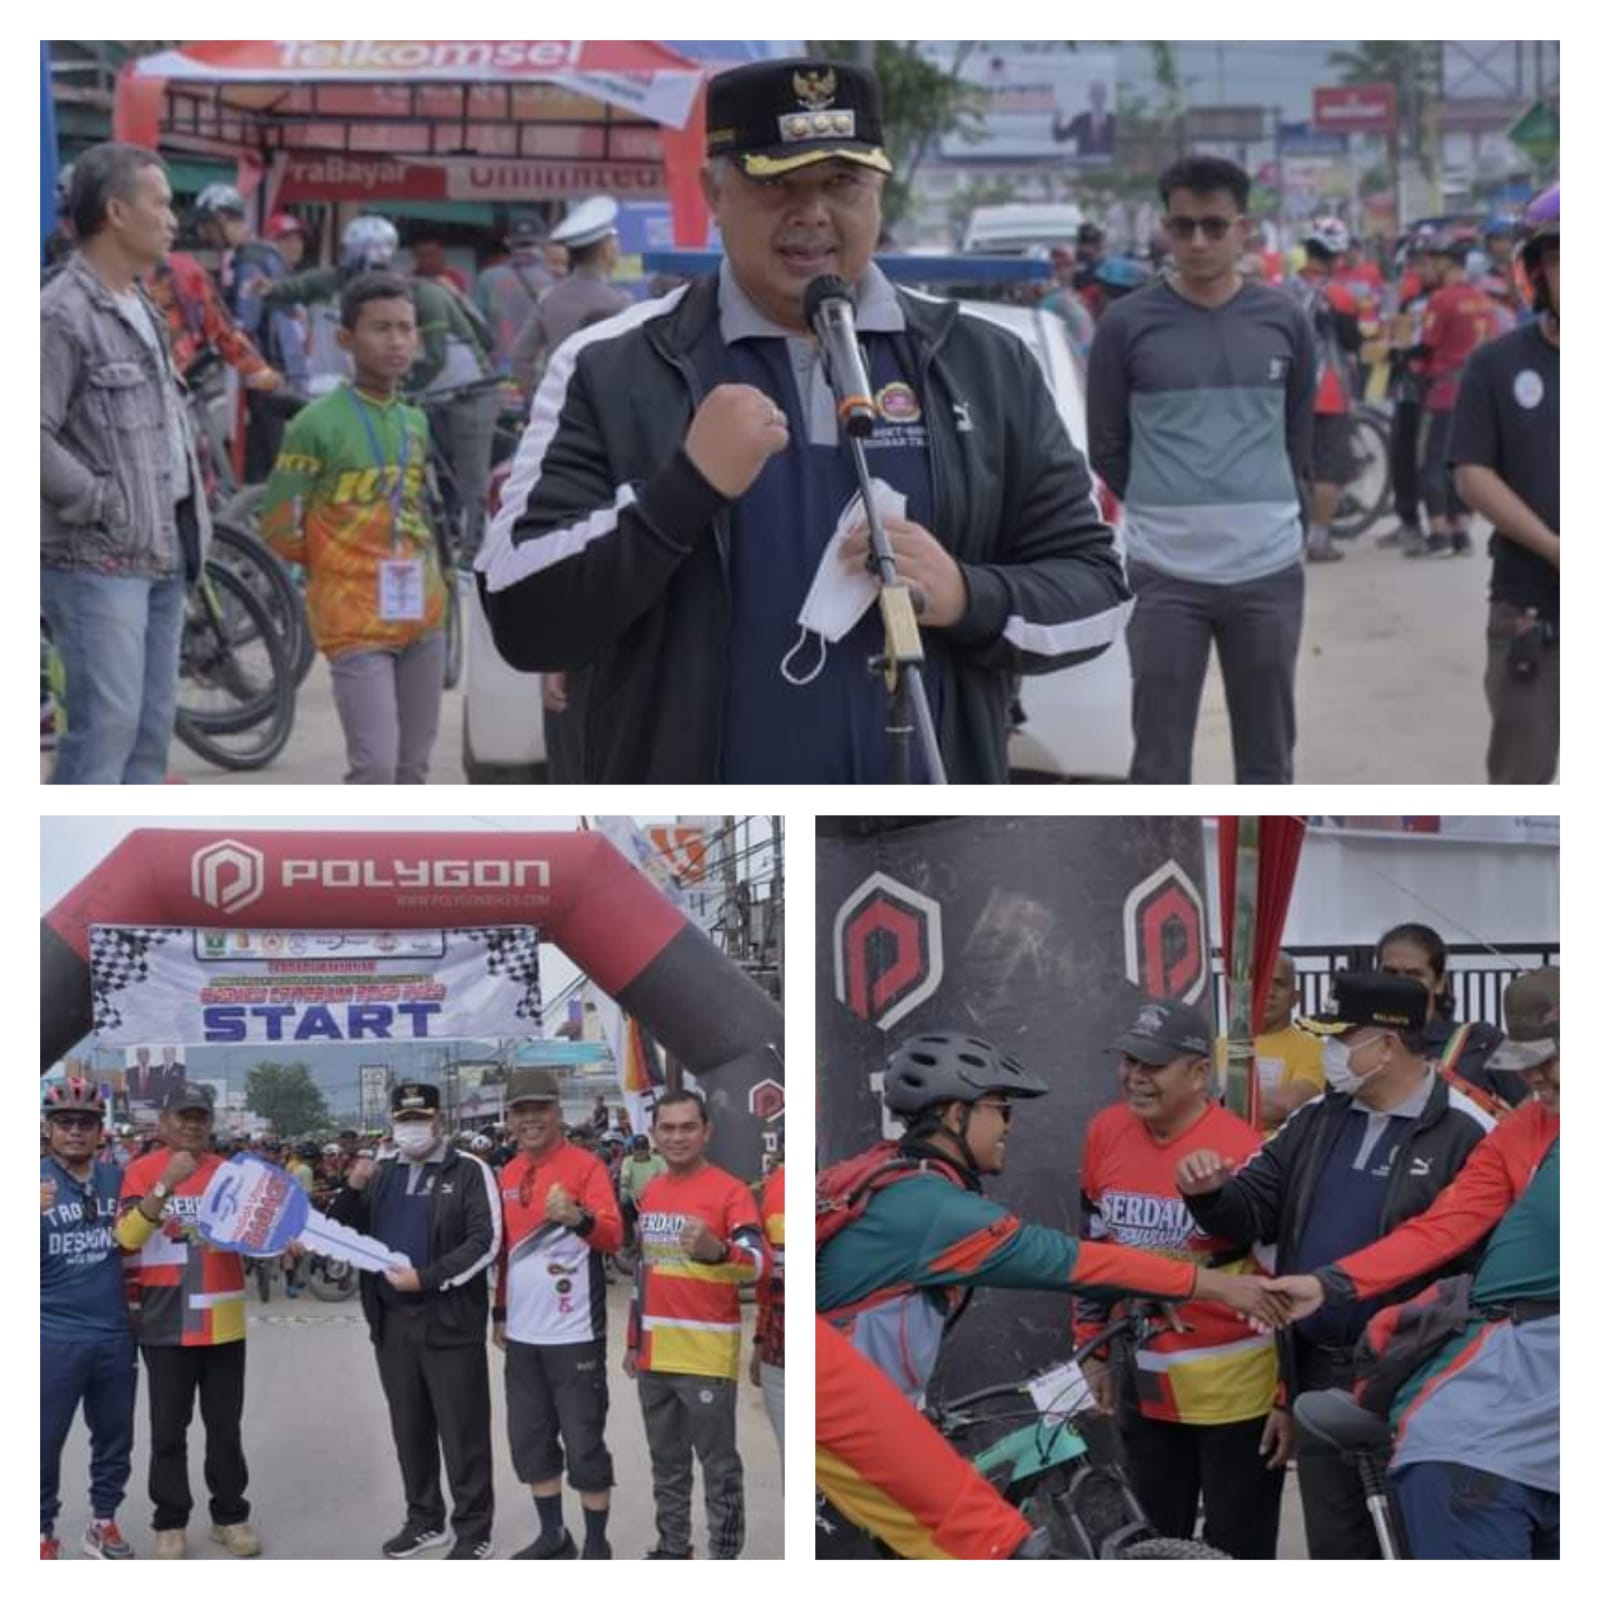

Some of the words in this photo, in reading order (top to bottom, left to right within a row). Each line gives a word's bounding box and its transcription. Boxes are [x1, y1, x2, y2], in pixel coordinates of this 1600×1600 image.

[276, 40, 583, 67] Telkomsel
[281, 859, 550, 888] POLYGON
[203, 1002, 442, 1042] START
[1095, 1192, 1206, 1235] SERDAD
